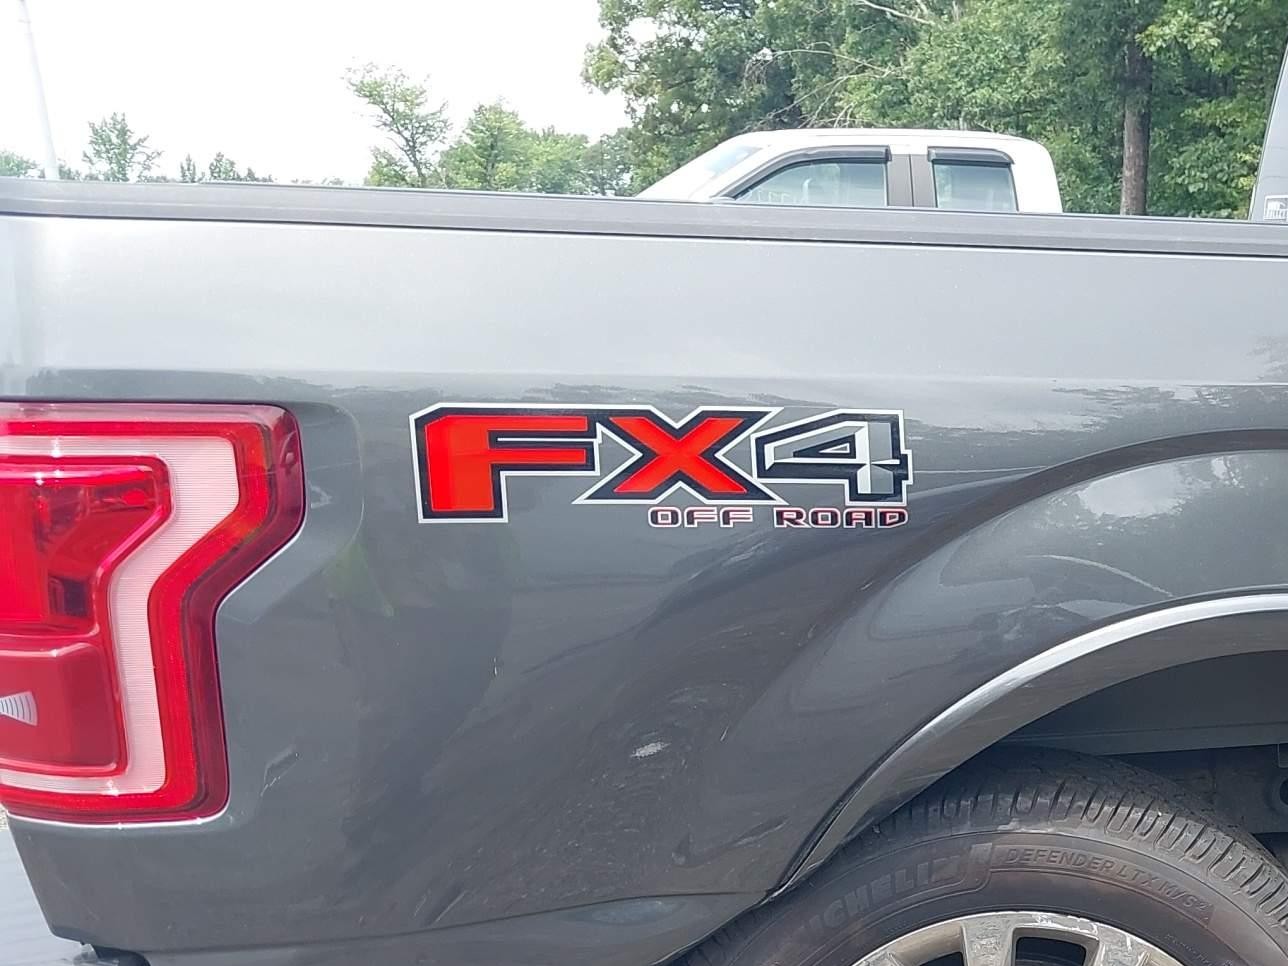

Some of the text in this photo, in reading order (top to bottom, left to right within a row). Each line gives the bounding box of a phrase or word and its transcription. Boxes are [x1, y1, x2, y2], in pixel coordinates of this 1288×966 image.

[409, 402, 913, 524] FX4
[648, 506, 909, 528] OFF ROAD
[1004, 848, 1115, 873] DEFENDER
